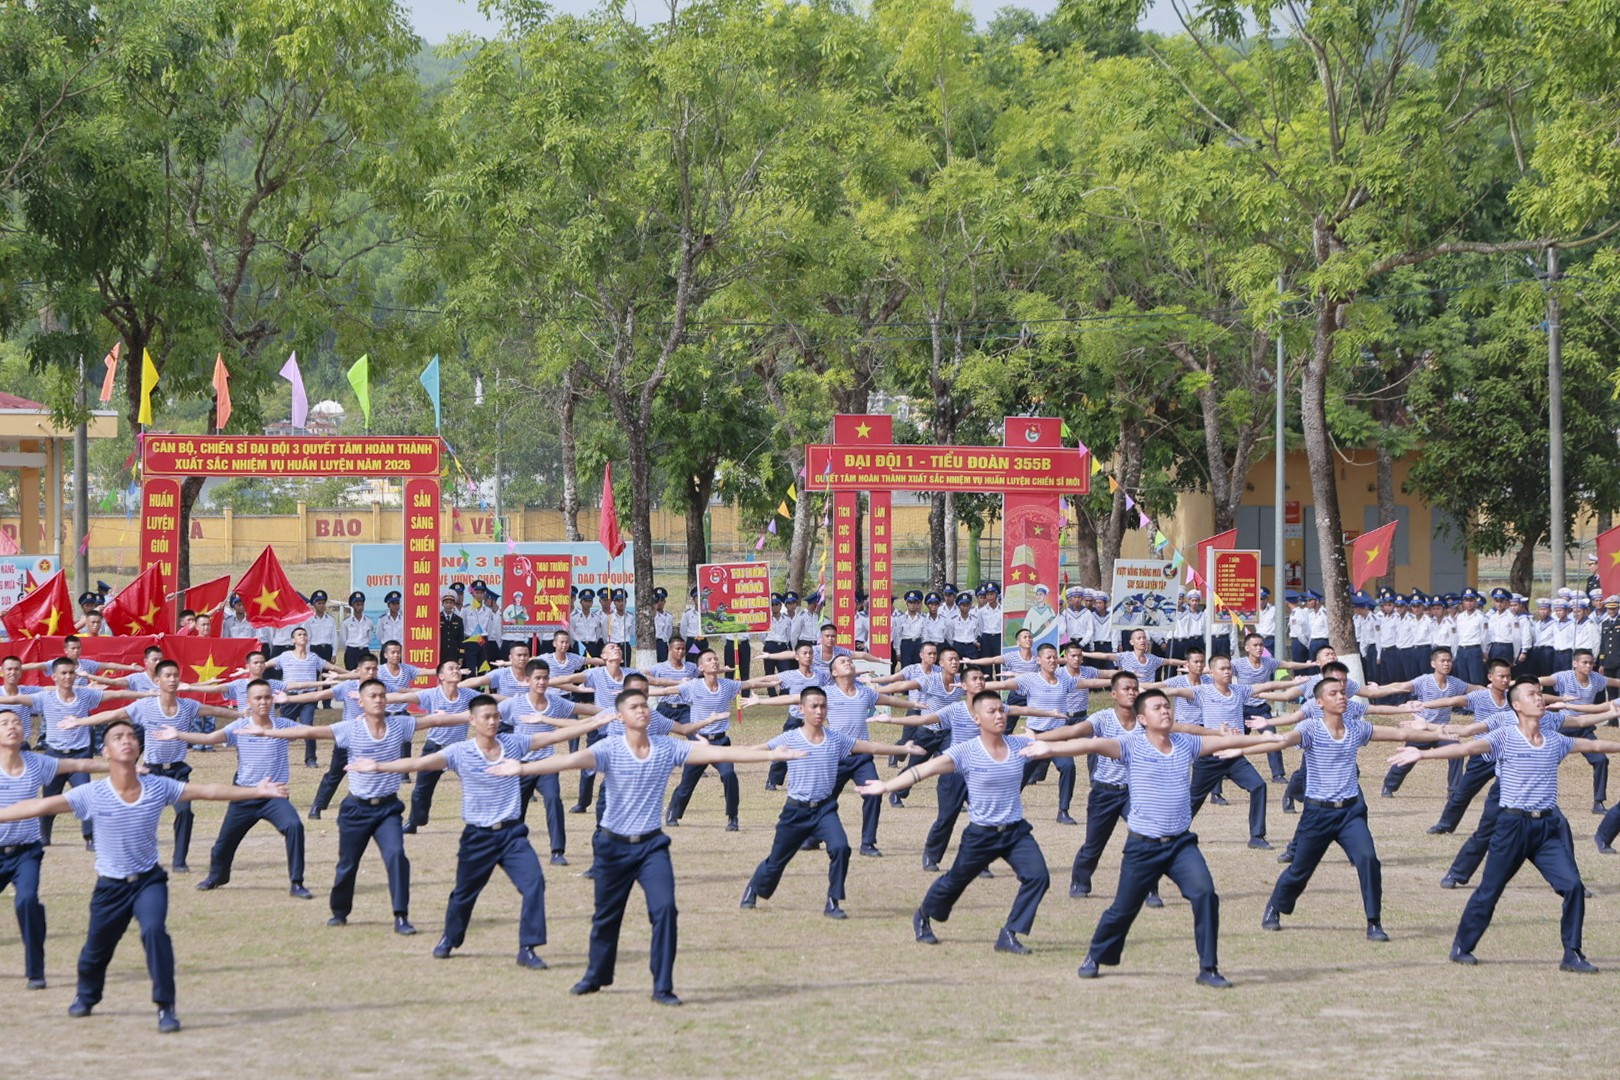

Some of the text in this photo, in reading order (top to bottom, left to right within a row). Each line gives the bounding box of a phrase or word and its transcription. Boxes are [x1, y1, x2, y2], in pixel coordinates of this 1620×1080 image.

[152, 440, 432, 456] CÁN BỘ, CHIẾN SĨ ĐẠI ĐỘI 3 QUYẾT TÂM HOÀN THÀNH
[175, 456, 411, 472] XUẤT SẮC NHIỆM VỤ HUẤN LUYỆN NĂM 2026
[844, 455, 871, 470] ĐẠI
[875, 452, 901, 470] ĐỘI
[906, 456, 914, 467] 1
[930, 451, 963, 468] TIỂU
[967, 455, 1009, 469] ĐOÀN
[1014, 458, 1052, 470] 355B
[840, 473, 857, 483] TÂM
[858, 473, 880, 483] HOÀN
[881, 473, 906, 483] THÀNH
[908, 472, 927, 484] XUẤT
[930, 473, 944, 484] SẮC
[946, 475, 971, 486] NHIỆM
[973, 476, 982, 486] VỤ
[984, 475, 1005, 485] HUẤN
[1006, 475, 1029, 487] LUYỆN
[1032, 475, 1054, 486] CHIẾN
[1056, 476, 1064, 486] SĨ
[1066, 476, 1080, 487] MỚI
[149, 490, 174, 507] HUẤN
[147, 514, 174, 534] LUYỆN
[316, 512, 362, 537] BẢO
[411, 514, 434, 529] SÀNG
[151, 535, 169, 553] GIỎI
[409, 535, 435, 551] CHIẾN
[414, 556, 431, 574] ĐẤU
[475, 556, 487, 567] 3
[366, 573, 394, 587] QUYẾT
[414, 583, 430, 596] CAO
[416, 605, 428, 618] AN
[411, 624, 433, 640] TOÀN
[409, 646, 434, 665] TUYỆT
